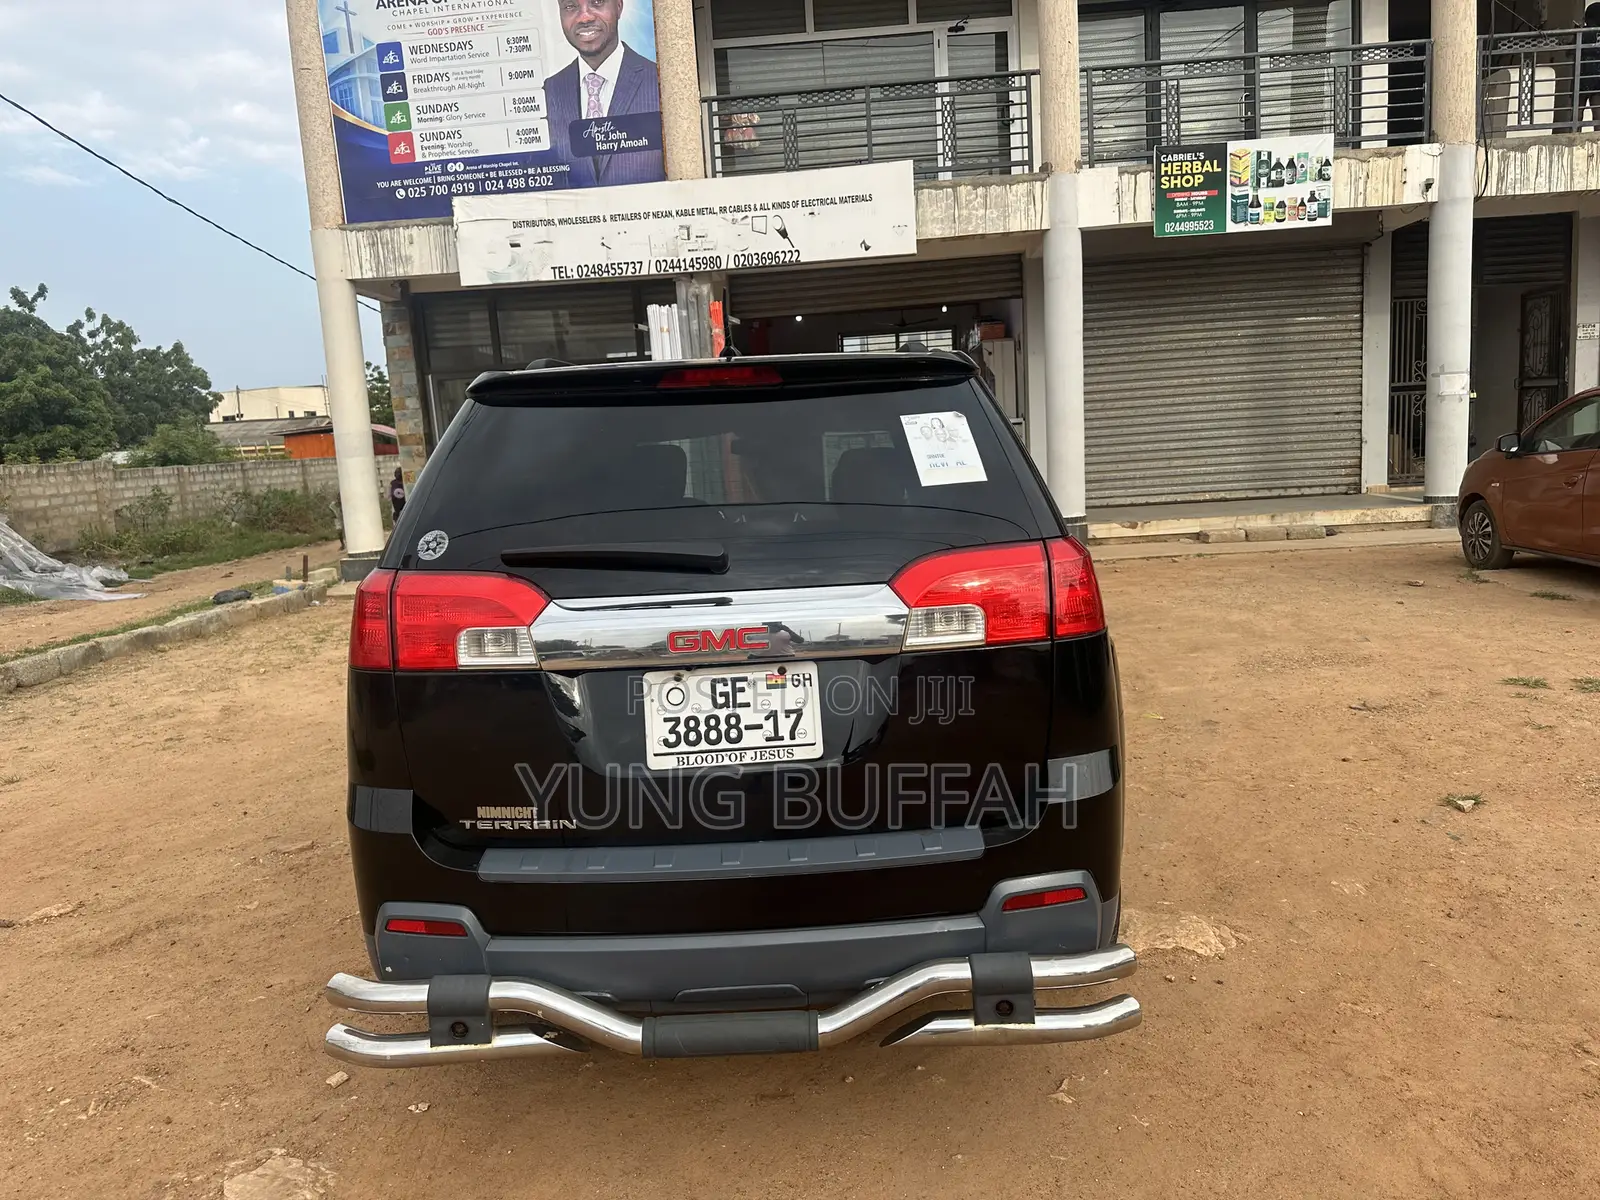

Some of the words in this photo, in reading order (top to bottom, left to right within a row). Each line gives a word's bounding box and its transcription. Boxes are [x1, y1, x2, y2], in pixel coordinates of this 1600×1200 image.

[392, 7, 429, 17] CHAPEL
[433, 0, 515, 13] INTERNATIONAL
[414, 19, 445, 28] WORSHIP
[481, 11, 523, 21] EXPERIENCE
[427, 27, 449, 36] GOD'S
[451, 24, 485, 34] PRESENCE
[506, 35, 530, 45] 6:30PM
[408, 40, 474, 55] WEDNESDAYS
[509, 45, 532, 54] 7:30PM
[429, 54, 466, 64] Impartation
[468, 51, 490, 60] Service
[412, 72, 451, 84] FRIDAYS
[508, 70, 535, 80] 9:00PM
[413, 84, 457, 94] Breakthrough
[457, 81, 486, 91] All-Night
[512, 96, 536, 105] 8:00AM
[416, 102, 460, 115] SUNDAYS
[514, 104, 540, 114] 10:00AM
[417, 115, 445, 124] Morning:
[445, 113, 463, 122] Glory
[516, 127, 539, 136] 4:00PM
[582, 121, 616, 138] Apostle
[595, 133, 606, 141] Dr.
[608, 131, 627, 140] John
[419, 130, 463, 143] SUNDAYS
[519, 136, 542, 145] 7:00PM
[420, 143, 446, 151] Evening:
[447, 141, 473, 149] Worship
[596, 141, 618, 151] Harry
[620, 137, 648, 148] Amoah
[428, 149, 457, 158] Prophetic
[458, 147, 480, 155] Service
[1160, 152, 1205, 162] GABRIEL'S
[428, 164, 442, 172] LIVE
[1161, 160, 1222, 175] HERBAL
[376, 181, 390, 189] YOU
[390, 180, 402, 188] ARE
[403, 177, 433, 187] WELCOME
[437, 173, 456, 182] BRING
[456, 171, 485, 181] SOMEONE
[498, 169, 523, 177] BLESSED
[542, 165, 570, 174] BLESSING
[1160, 174, 1204, 189] SHOP
[407, 187, 427, 198] 025
[430, 184, 448, 196] 700
[451, 182, 475, 194] 4919
[485, 180, 504, 192] 024
[506, 178, 526, 189] 498
[529, 175, 554, 187] 6202
[512, 218, 557, 229] DISTRIBUTORS,
[557, 215, 601, 226] WHOLESELERS
[602, 215, 607, 223] &
[610, 213, 642, 222] RETAILERS
[643, 211, 651, 219] OF
[652, 210, 675, 220] NEXAN,
[675, 208, 695, 218] KABLE
[696, 207, 718, 216] METAL,
[719, 206, 728, 214] RR
[728, 204, 752, 214] CABLES
[753, 203, 758, 211] &
[759, 202, 771, 211] ALL
[771, 201, 790, 210] KINDS
[791, 200, 799, 209] OF
[801, 197, 838, 208] ELECTRICAL
[838, 193, 873, 204] MATERIALS
[1164, 220, 1214, 232] 0244995523
[551, 266, 574, 279] TEL:
[576, 261, 643, 278] 0248455737
[655, 255, 722, 273] 0244145980
[733, 249, 801, 268] 0203696222
[666, 626, 770, 653] GMC
[710, 676, 751, 710] GE
[791, 673, 813, 688] GH
[662, 708, 804, 749] 3888-17
[676, 754, 726, 766] BLOOD
[728, 752, 747, 763] OF
[750, 748, 795, 762] JESUS
[476, 806, 538, 819] NIMNICHT
[459, 819, 577, 830] TERRAIN
